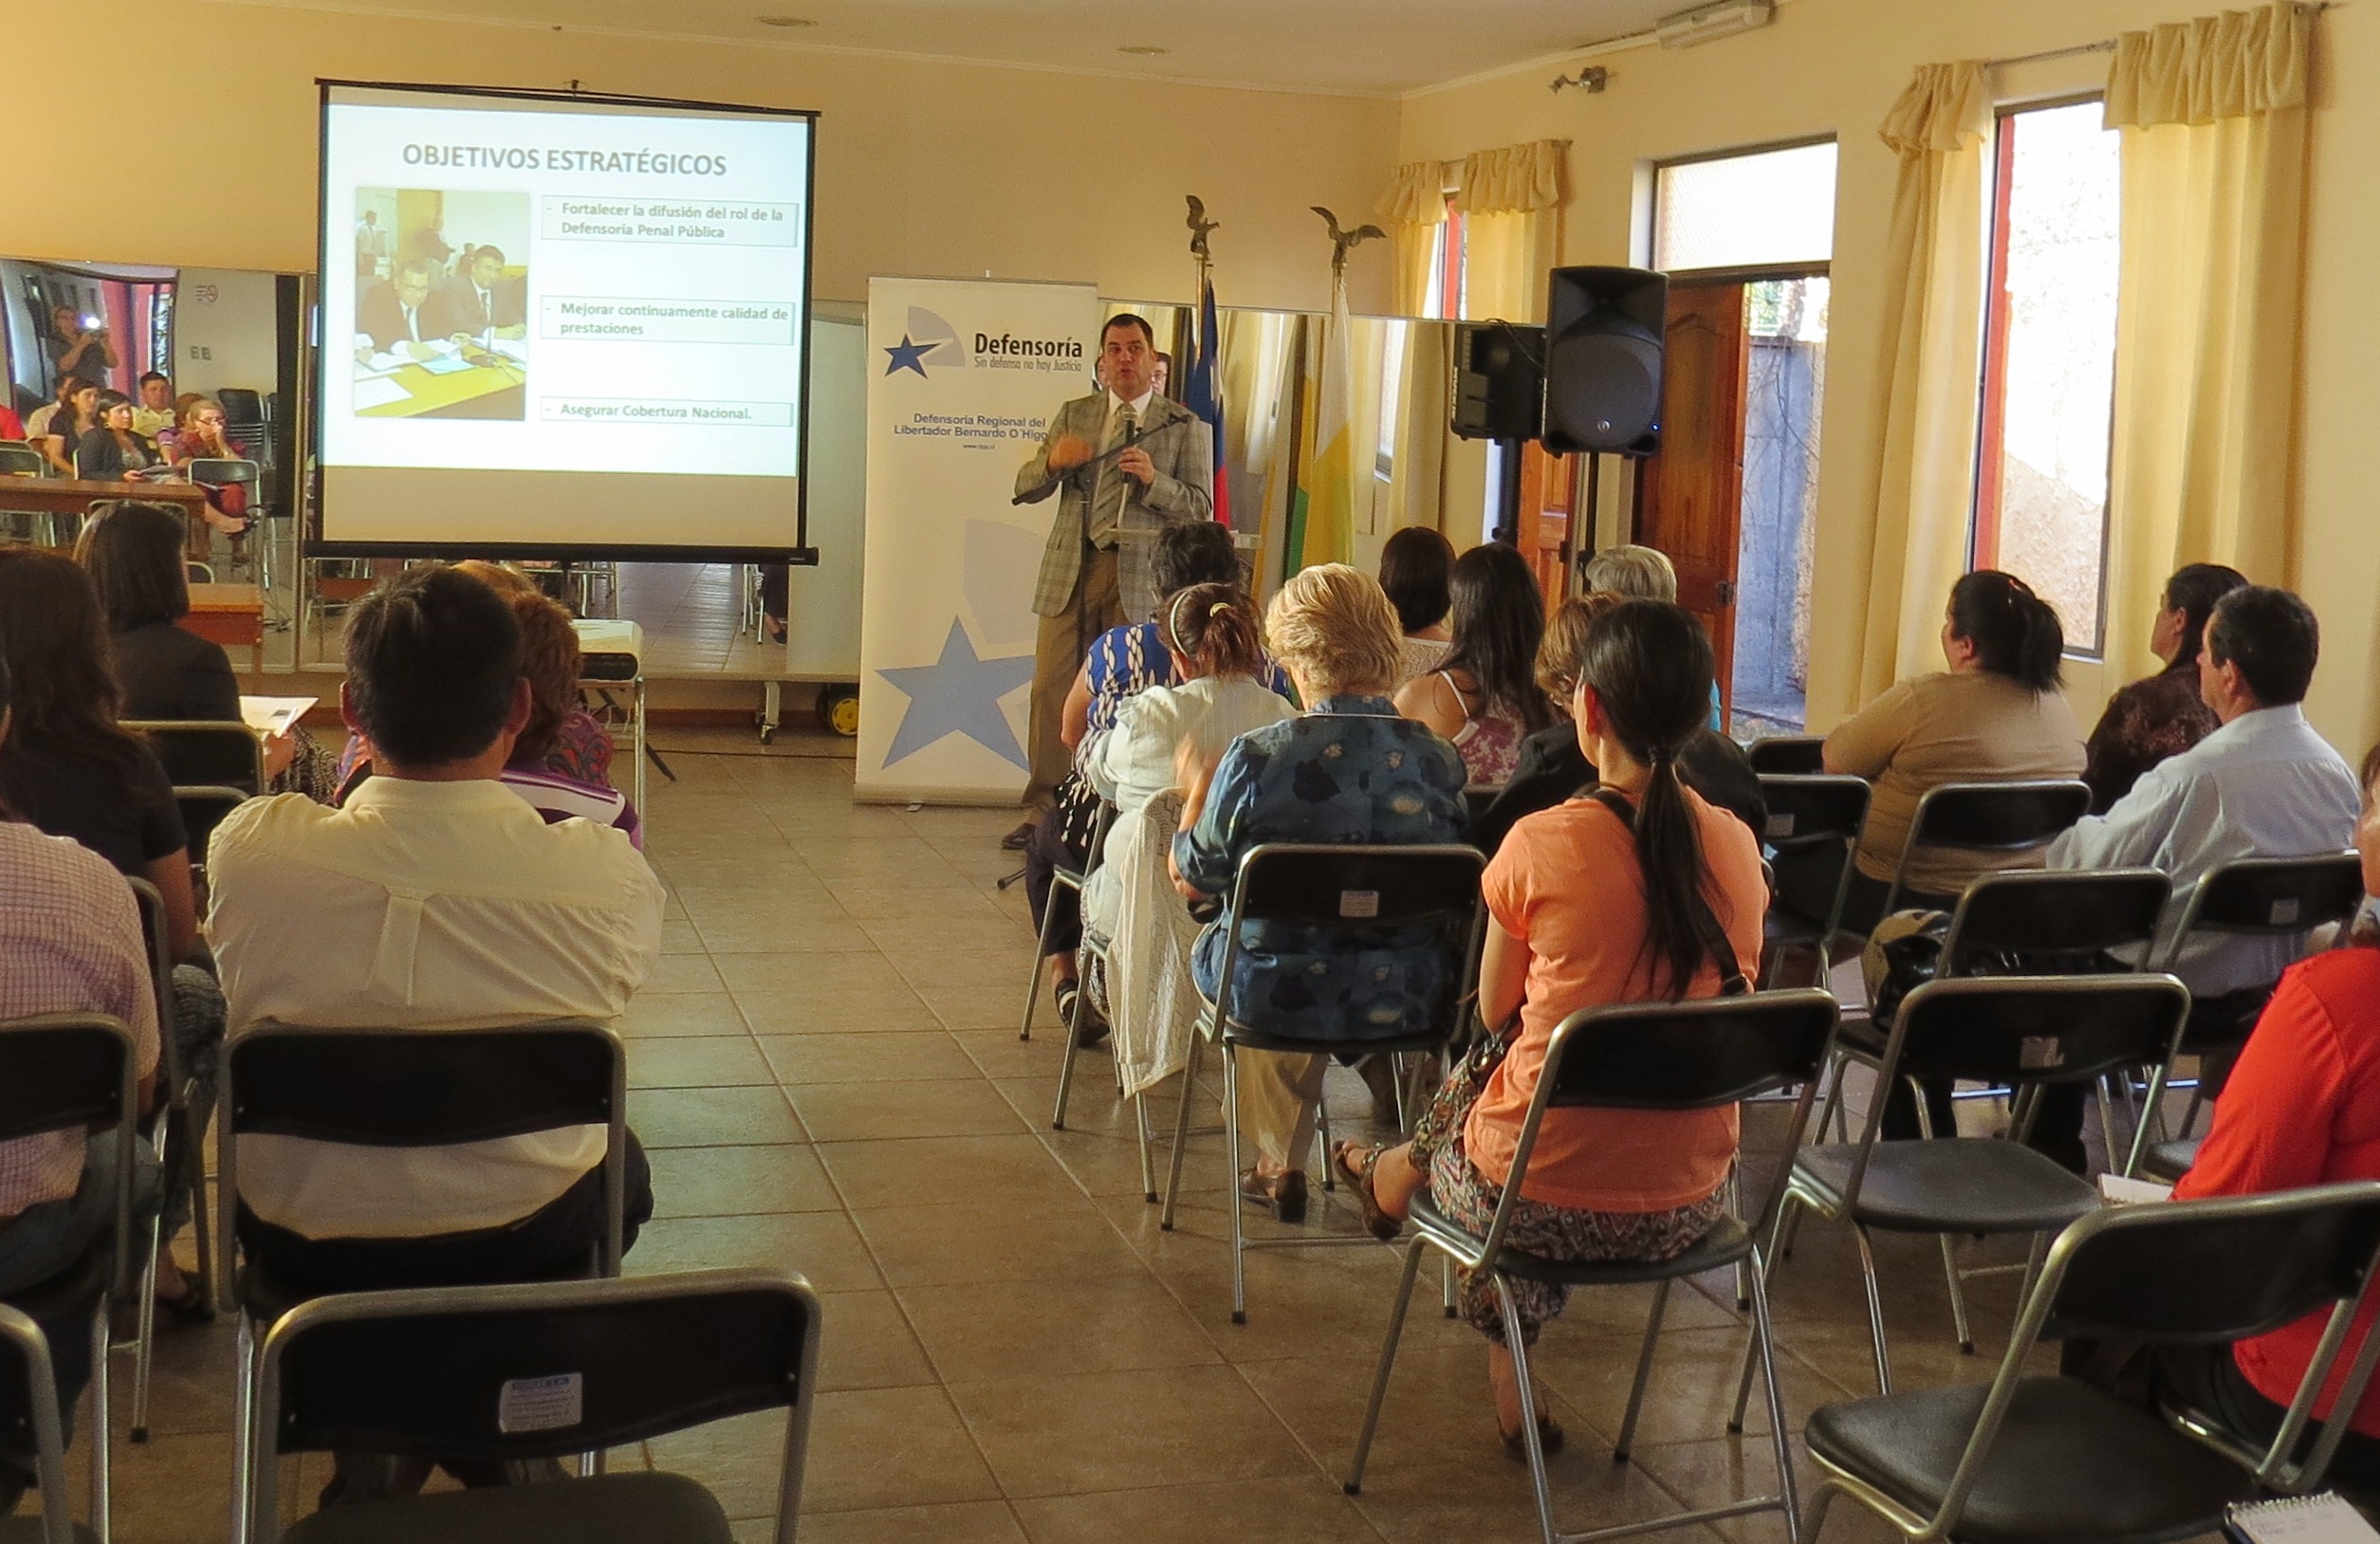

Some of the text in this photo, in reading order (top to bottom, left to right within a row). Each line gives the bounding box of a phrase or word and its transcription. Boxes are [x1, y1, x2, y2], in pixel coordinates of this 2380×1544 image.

[402, 143, 728, 176] OBJETIVOS ESTRATÉGICOS
[562, 202, 784, 221] Fortalecer la difusión del rol de la
[637, 224, 674, 236] Penal
[677, 225, 725, 238] Pública
[561, 303, 788, 321] Mejorar continuamente calidad de
[561, 322, 644, 335] prestaciones
[975, 333, 1082, 358] Defensoría
[974, 357, 1082, 373] Sin defensa no hay Justicia
[560, 403, 752, 419] Asegurar Cobertura Nacional.
[977, 415, 1026, 428] Regional
[1029, 417, 1046, 427] del
[894, 425, 951, 435] Libertador
[954, 427, 1006, 438] Bernardo
